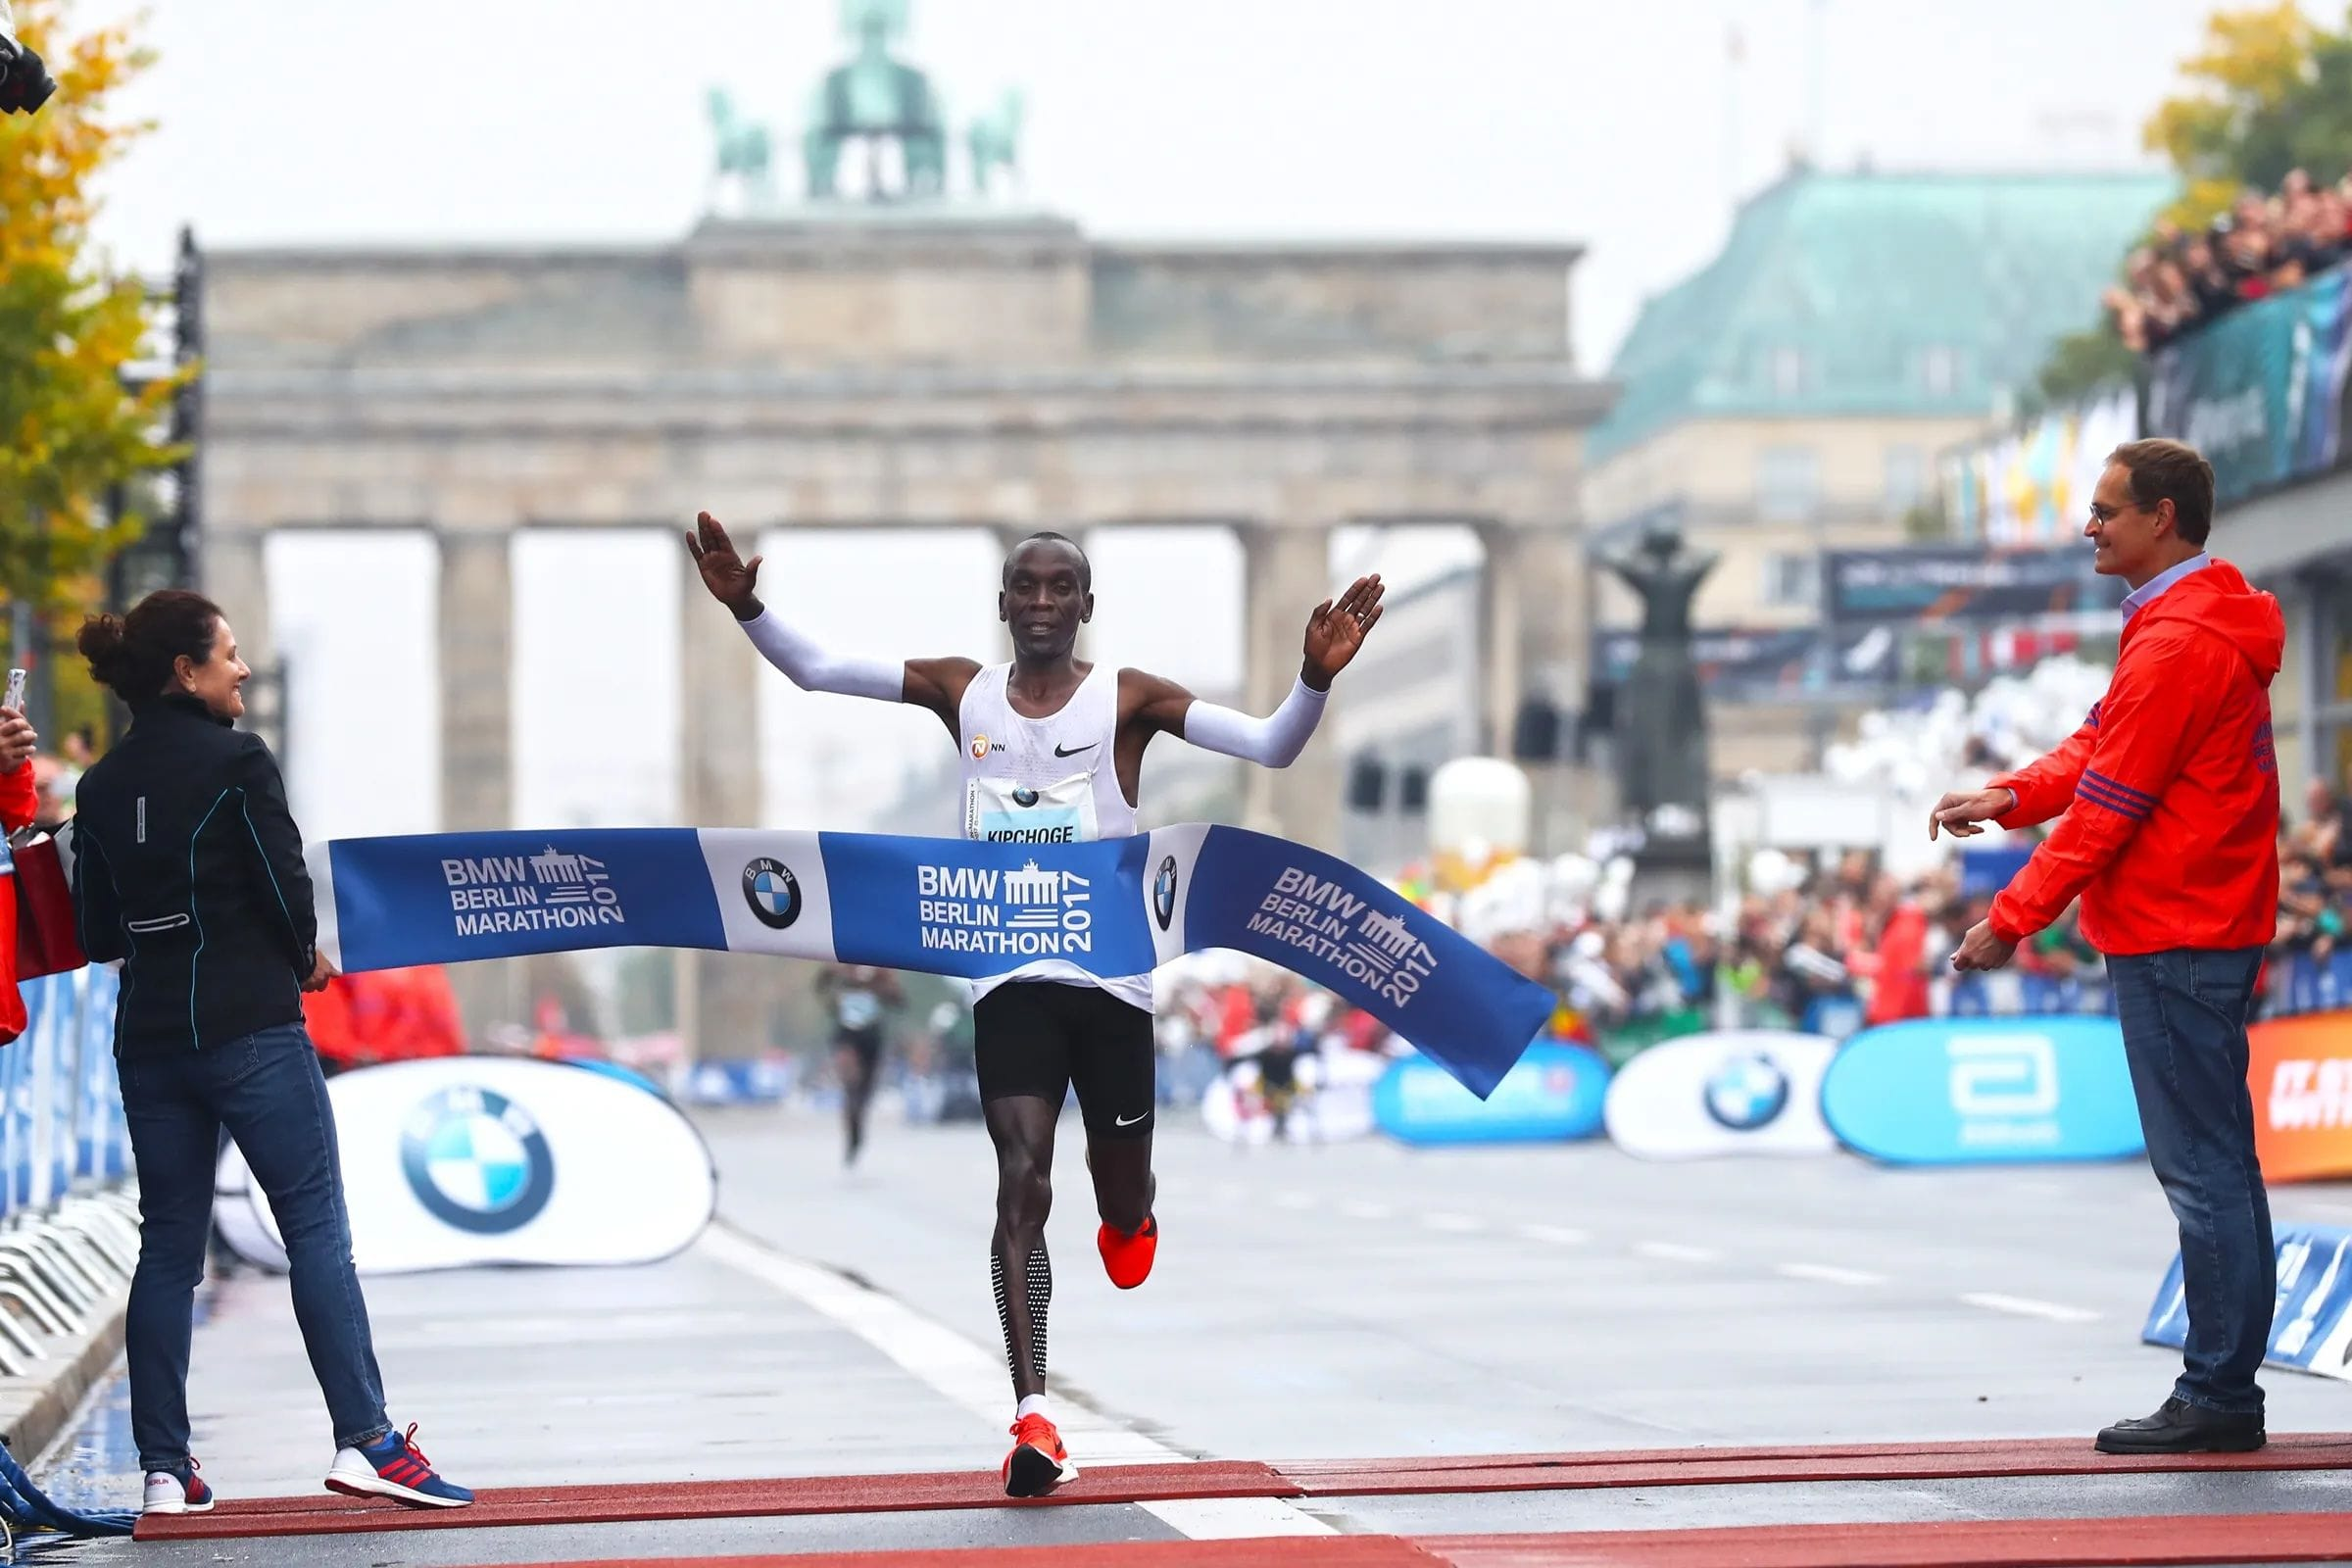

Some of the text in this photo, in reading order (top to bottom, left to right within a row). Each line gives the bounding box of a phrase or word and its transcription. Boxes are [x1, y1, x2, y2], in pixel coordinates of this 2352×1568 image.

[988, 825, 1074, 843] KIPCHOGE
[441, 857, 526, 886] BMW
[744, 859, 794, 883] BMW
[917, 865, 999, 900] BMW
[451, 886, 538, 910] BERLIN
[577, 855, 625, 924] 2017
[1273, 866, 1366, 919] BMW
[455, 906, 597, 936] MARATHON
[919, 900, 999, 927] BERLIN
[1061, 870, 1092, 953] 2017
[1259, 893, 1349, 941] BERLIN
[921, 926, 1059, 955] MARATHON
[1247, 912, 1385, 990] MARATHON
[1381, 942, 1438, 1008] 2017
